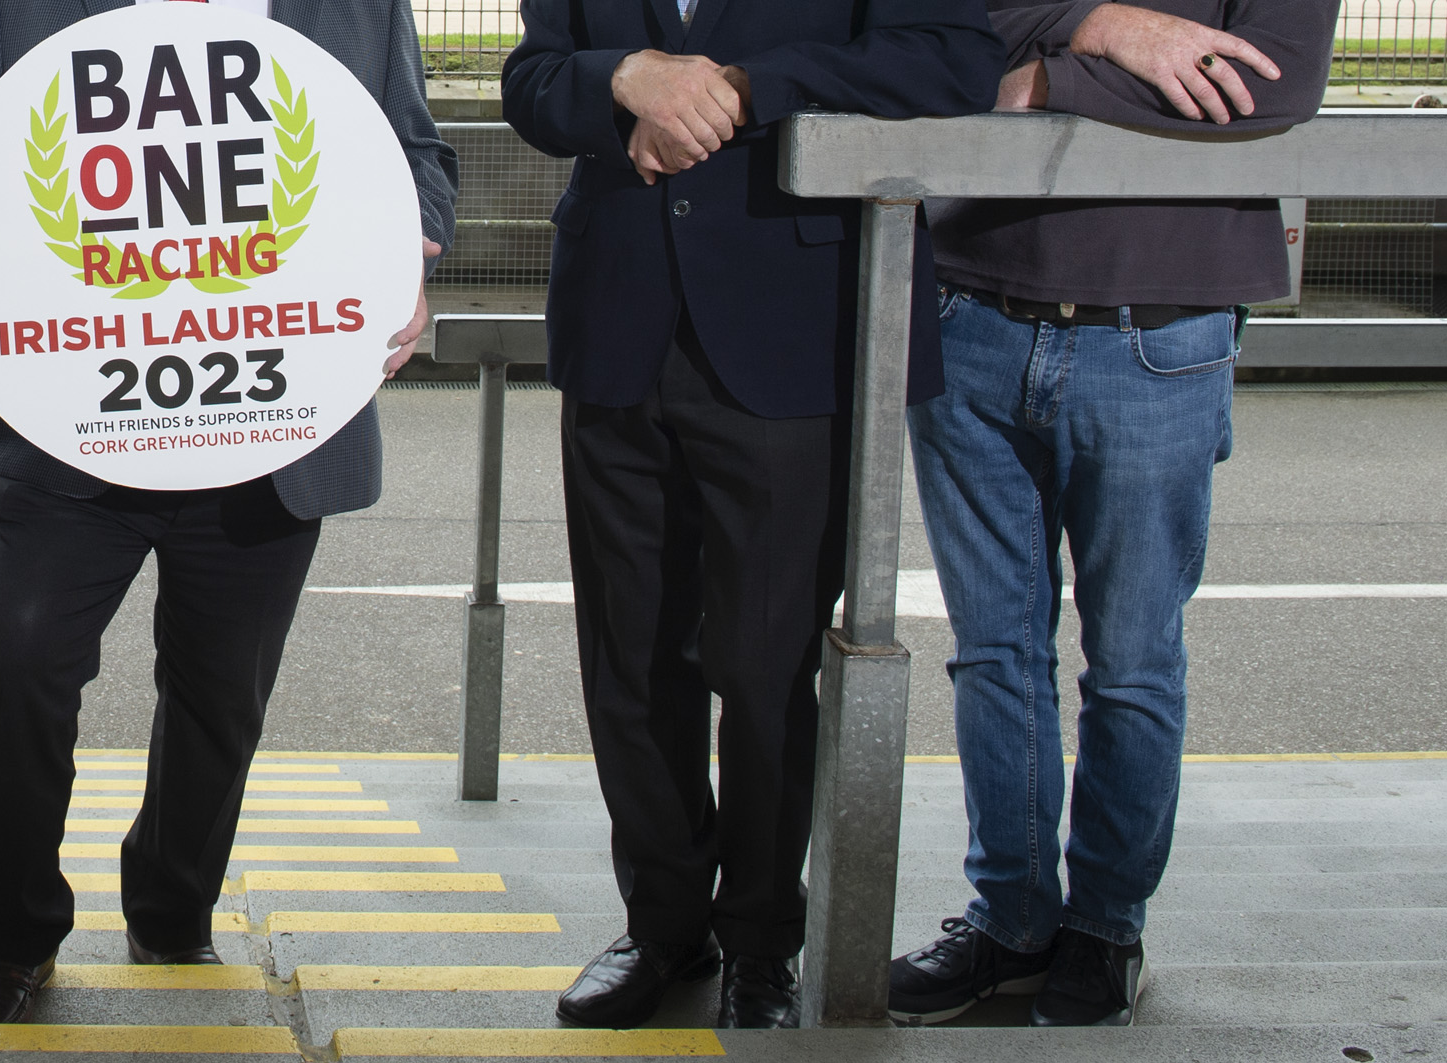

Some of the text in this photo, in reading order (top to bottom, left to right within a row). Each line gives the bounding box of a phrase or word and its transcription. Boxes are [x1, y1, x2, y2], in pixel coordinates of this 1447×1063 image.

[70, 39, 273, 135] BAR
[79, 137, 270, 230] ONE
[81, 232, 280, 286] RACING
[1285, 228, 1299, 245] G
[142, 297, 366, 347] LAURELS
[98, 348, 288, 413] 2023
[75, 406, 318, 434] WITH FRIENDS & SUPPORTERS OF
[79, 425, 317, 455] CORK GREYHOUND RACING
